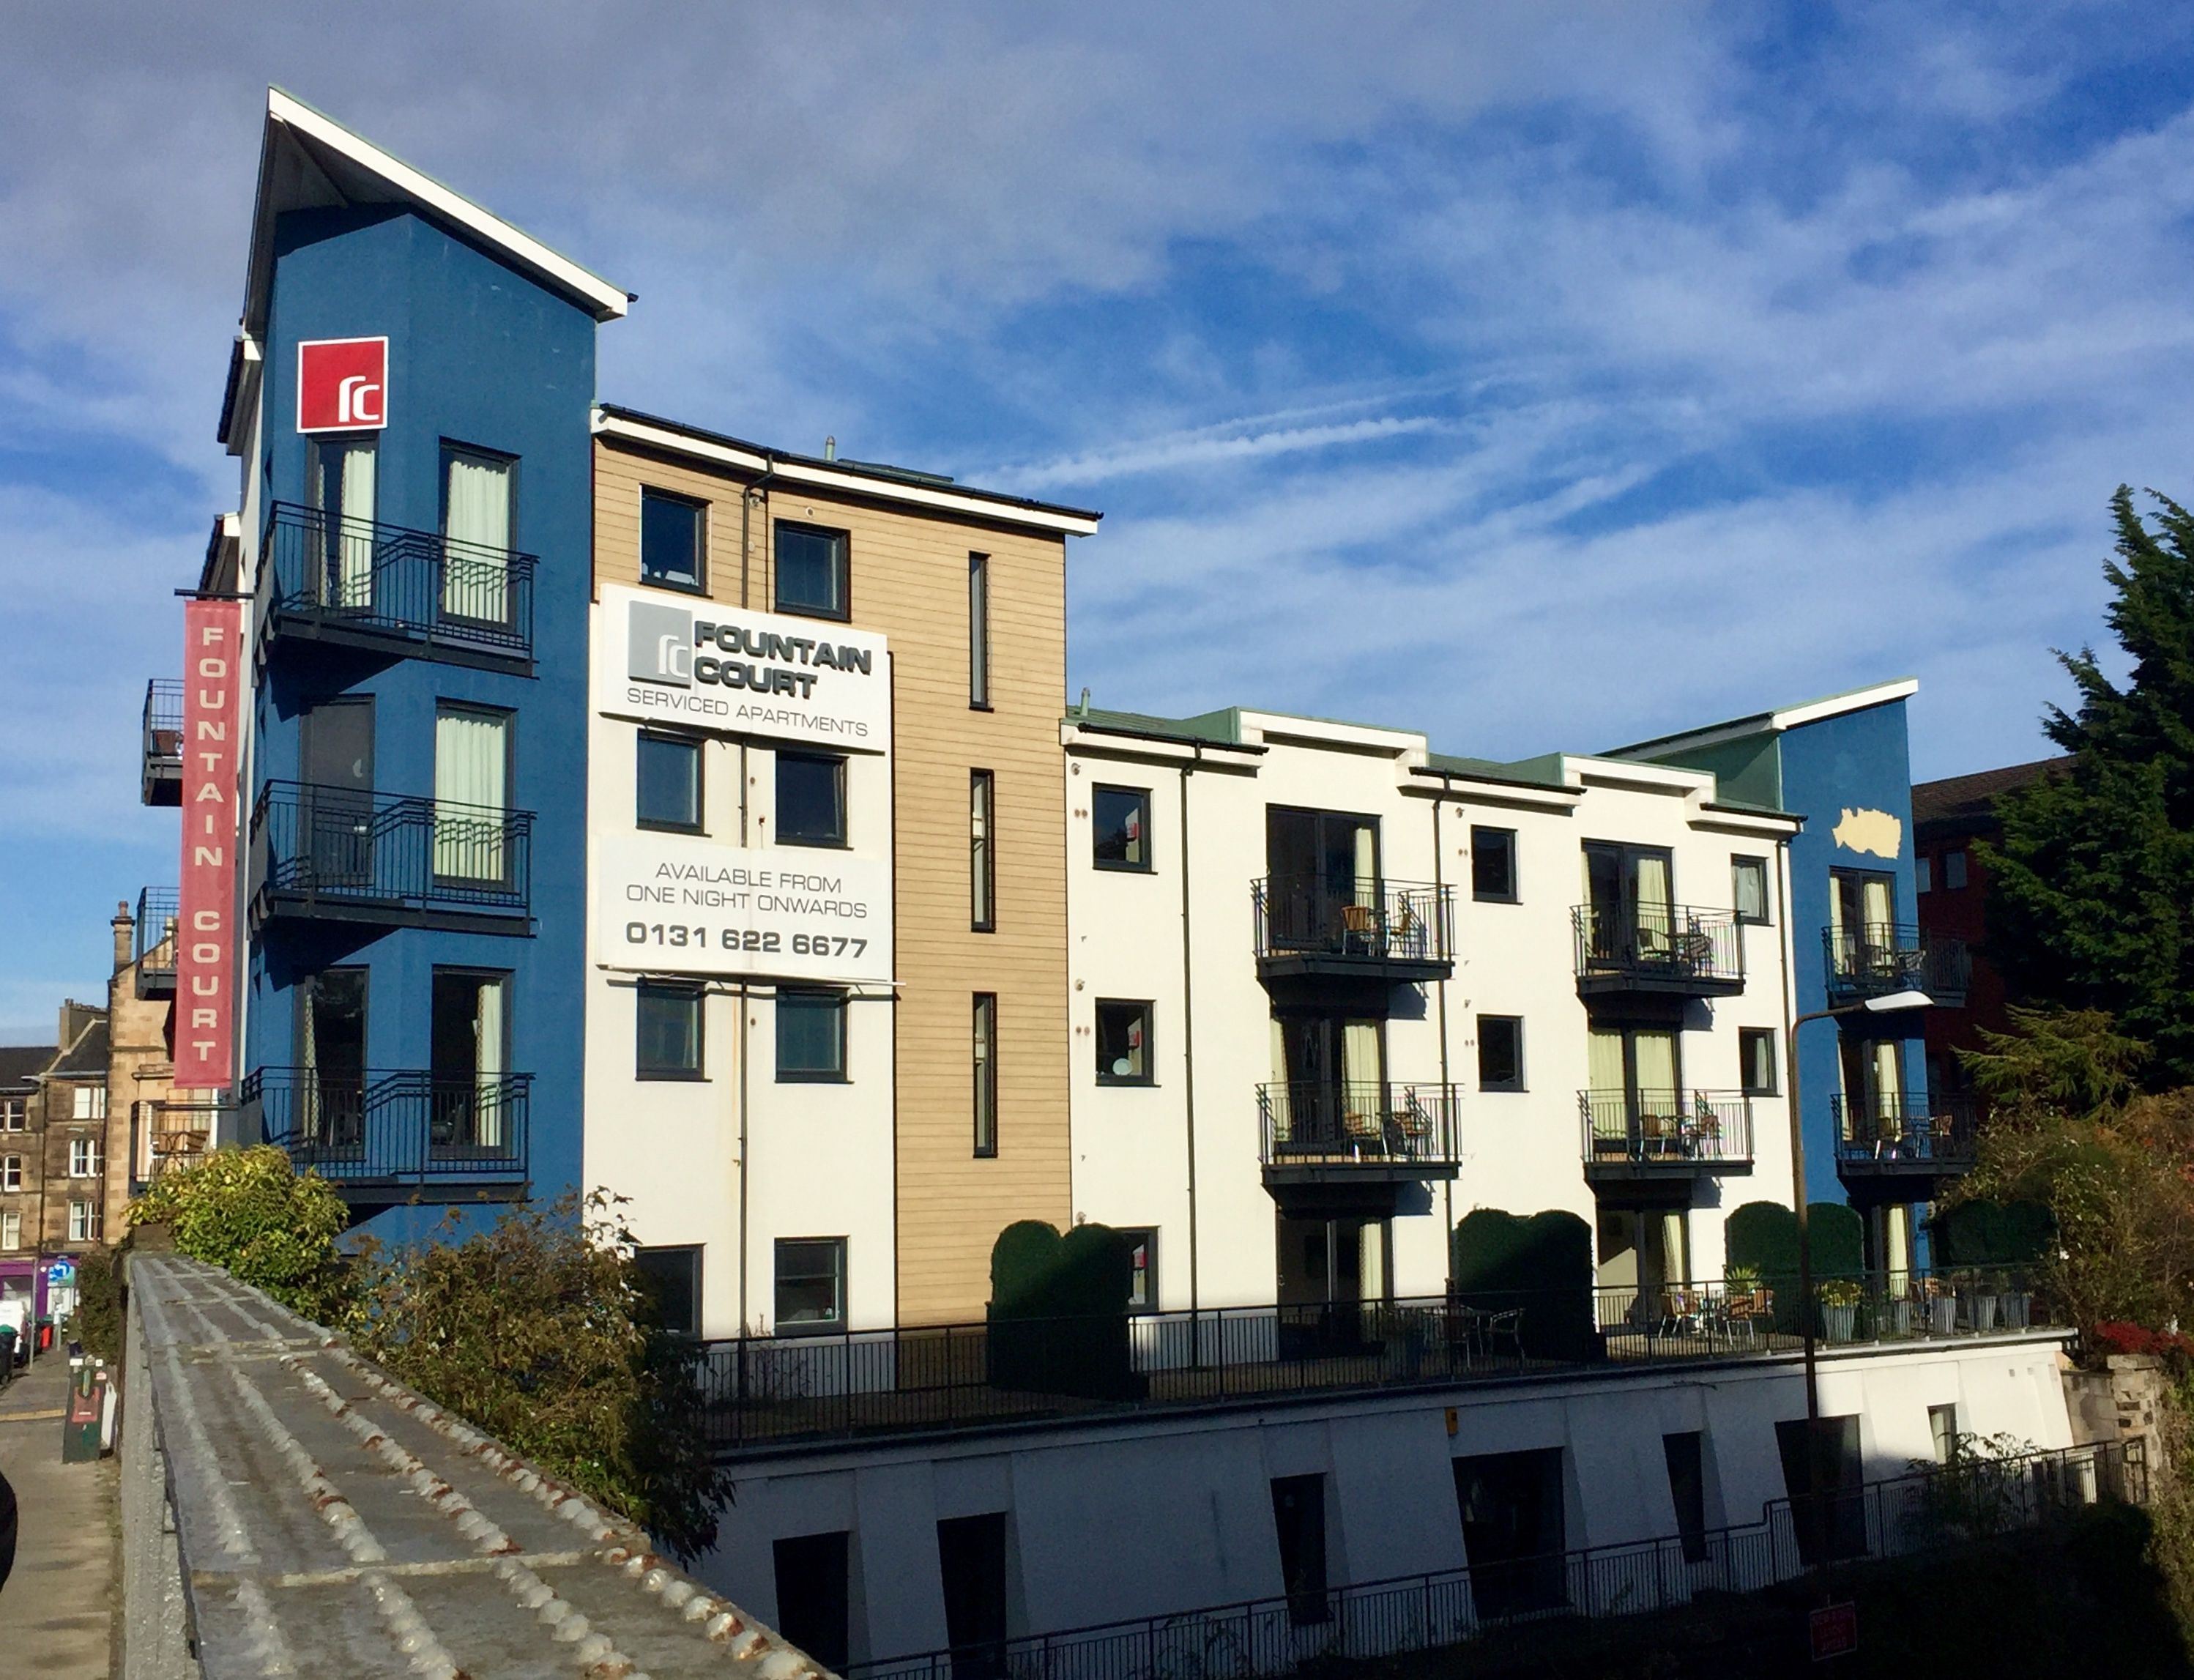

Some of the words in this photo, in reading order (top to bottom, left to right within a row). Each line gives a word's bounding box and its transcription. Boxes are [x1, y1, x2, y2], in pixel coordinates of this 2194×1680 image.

[694, 620, 871, 675] FOUNTAIN
[694, 656, 818, 699] COURT
[627, 687, 729, 716] SERVICED
[736, 704, 869, 737] APARTMENTS
[194, 626, 227, 866] FOUNTAIN
[655, 862, 772, 888] AVAILABLE
[780, 872, 841, 893] FROM
[626, 884, 675, 904] ONE
[683, 888, 750, 909] NIGHT
[758, 894, 867, 918] ONWARDS
[626, 921, 706, 948] 0131
[722, 929, 781, 953] 622
[792, 933, 868, 958] 6677
[192, 910, 220, 1062] COURT
